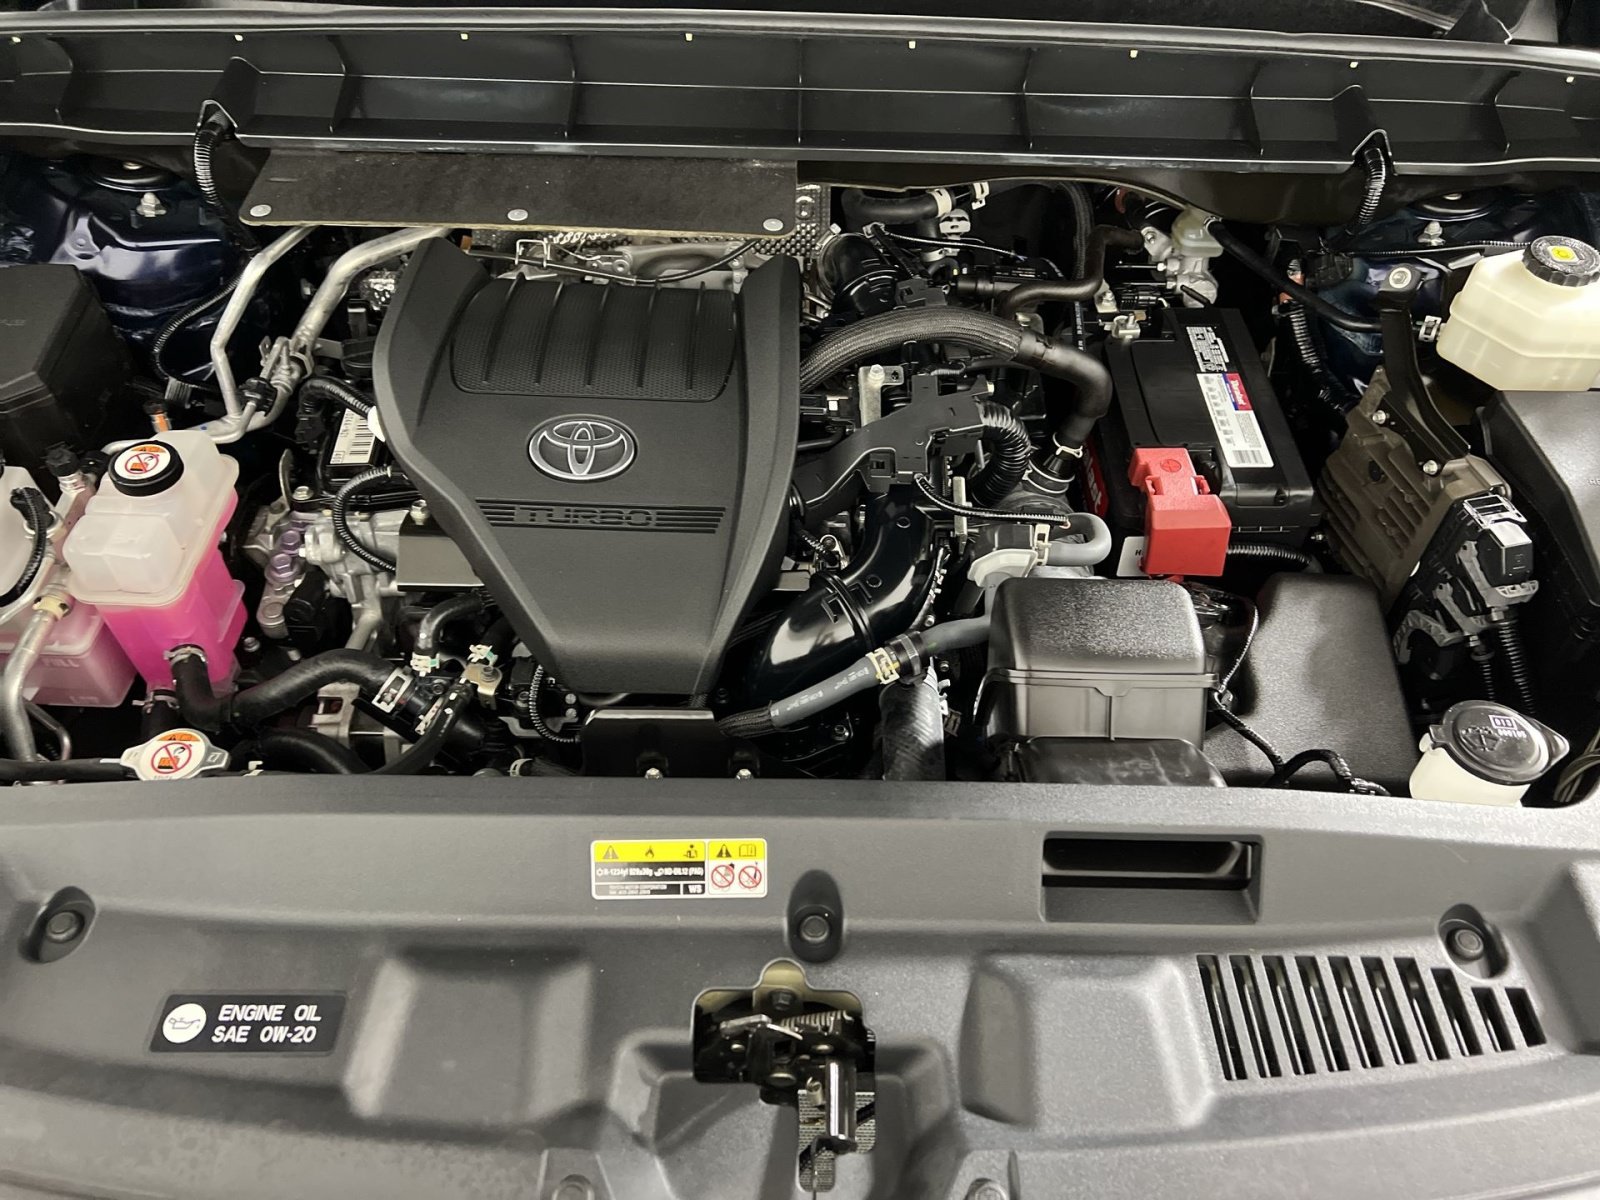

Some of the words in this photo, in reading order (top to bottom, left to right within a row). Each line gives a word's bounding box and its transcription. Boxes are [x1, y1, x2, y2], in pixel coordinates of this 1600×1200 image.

[514, 506, 656, 527] TURBO
[218, 1004, 286, 1022] ENGINE
[293, 1004, 322, 1022] OIL
[211, 1025, 252, 1043] SAE
[259, 1025, 318, 1043] 0W-20
